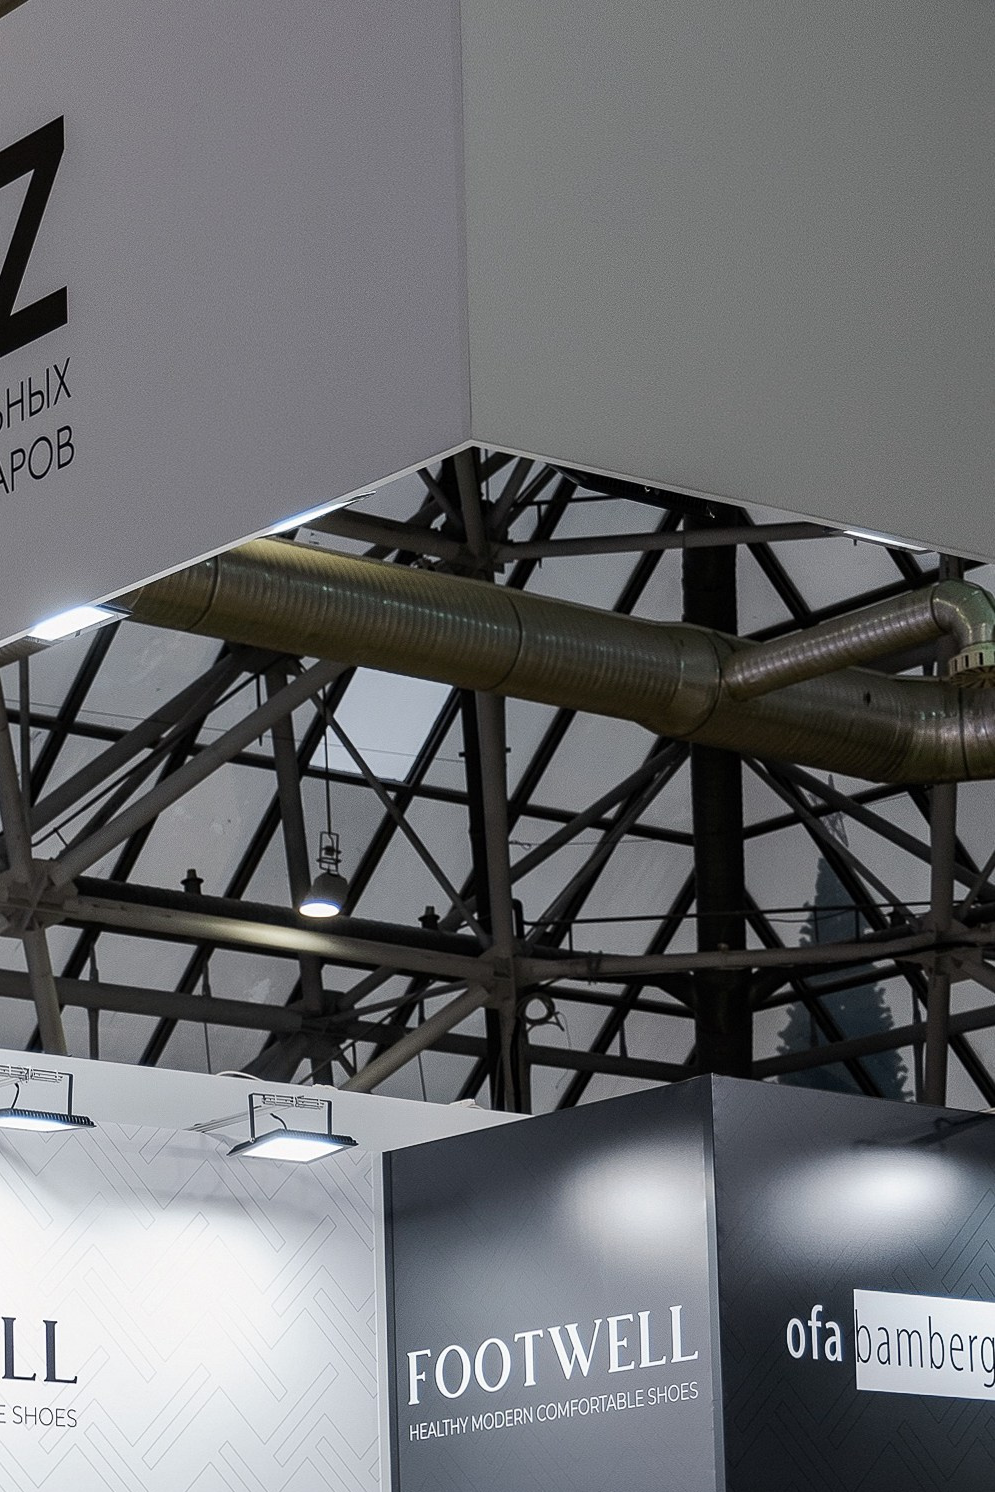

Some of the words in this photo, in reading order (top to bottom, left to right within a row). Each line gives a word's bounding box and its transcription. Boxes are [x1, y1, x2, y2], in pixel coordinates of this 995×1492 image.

[407, 1305, 699, 1406] FOOTWELL
[786, 1305, 843, 1362] ofa
[856, 1309, 995, 1388] bamberg
[12, 1405, 77, 1428] SHOES
[409, 1417, 468, 1441] HEALTHY
[472, 1406, 534, 1432] MODERN
[537, 1390, 645, 1423] COMFORTABLE
[648, 1381, 699, 1406] SHOES
